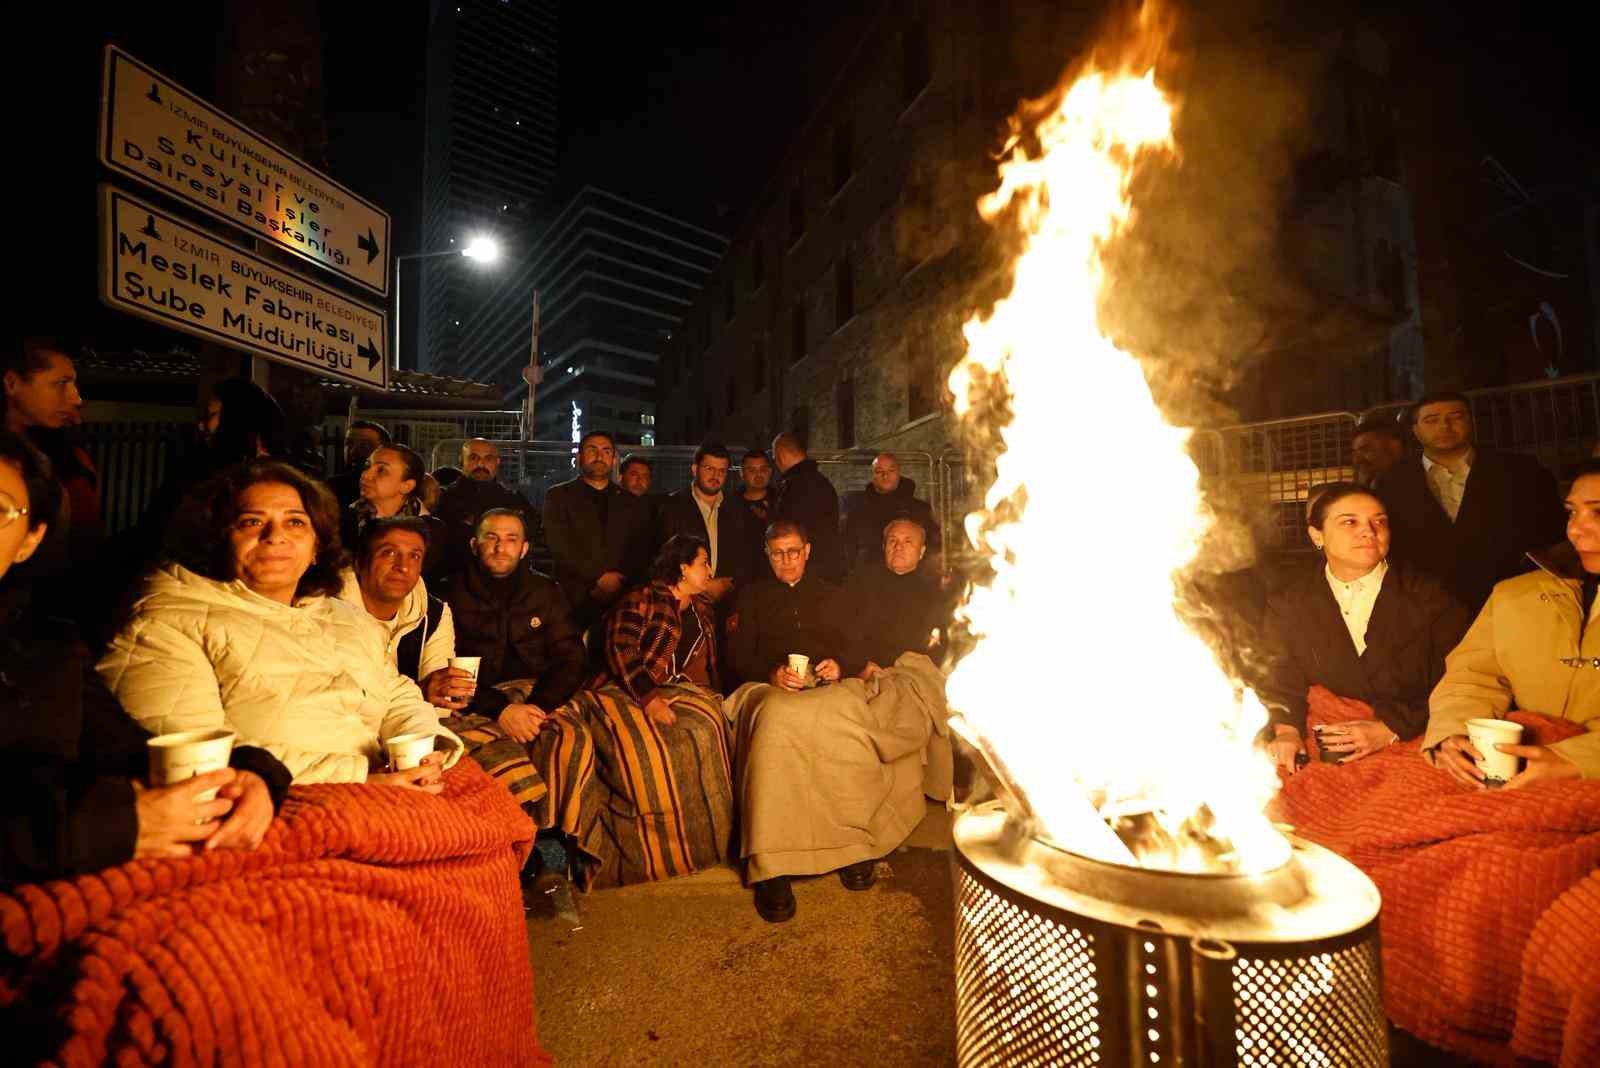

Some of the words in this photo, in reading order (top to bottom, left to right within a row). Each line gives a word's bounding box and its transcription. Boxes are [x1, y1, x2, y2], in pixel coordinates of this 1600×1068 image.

[123, 138, 225, 204] Dairesi
[237, 198, 351, 266] Başkanlığı
[157, 135, 262, 203] Sosyal
[274, 193, 333, 238] İşler
[186, 129, 284, 192] Kültür
[293, 192, 320, 213] ve
[119, 231, 232, 300] Meslek
[244, 284, 355, 345] Fabrikası
[124, 271, 206, 319] Şube
[222, 307, 352, 369] Müdürlüğü
